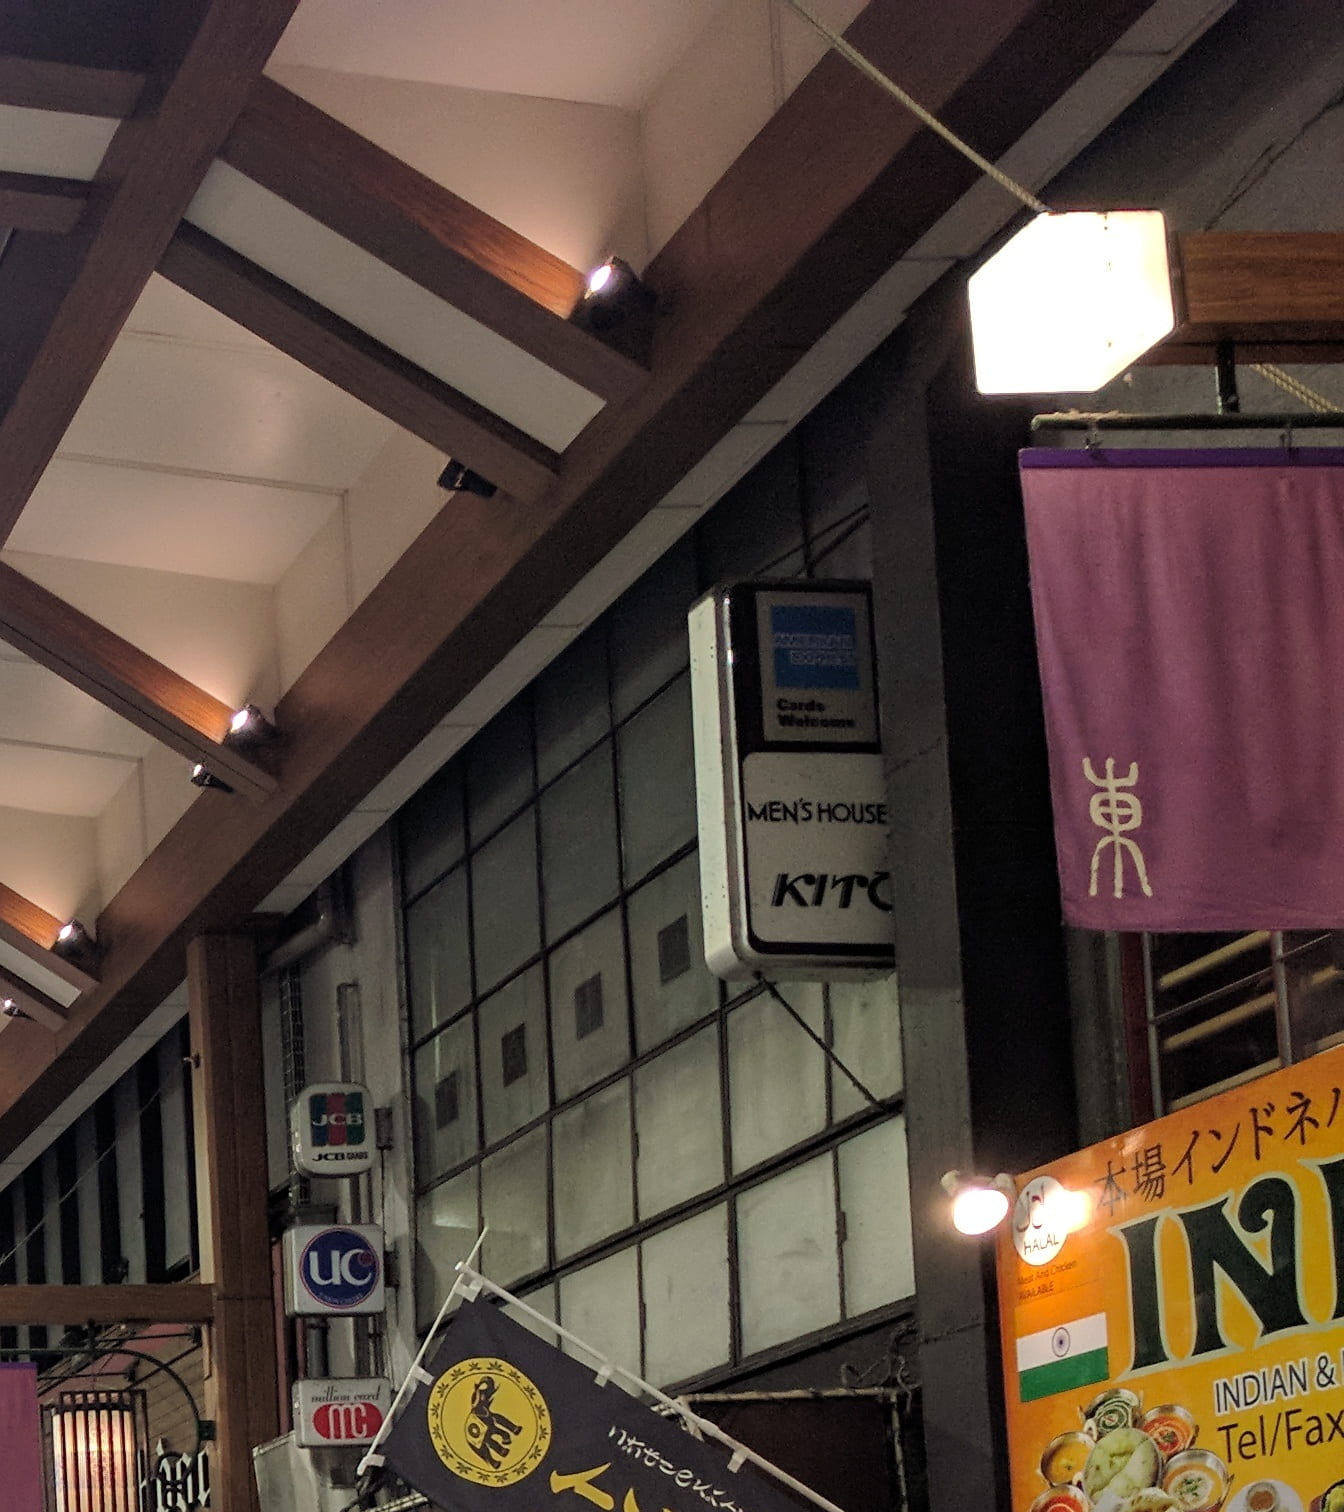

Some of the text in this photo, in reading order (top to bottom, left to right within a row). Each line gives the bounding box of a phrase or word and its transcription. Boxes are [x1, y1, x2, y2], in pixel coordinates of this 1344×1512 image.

[776, 698, 826, 713] Cards
[776, 713, 856, 729] Welcome
[747, 797, 888, 826] MEN'S HOUSE
[312, 1113, 363, 1126] JCB
[312, 1152, 345, 1162] JCB
[1024, 1234, 1060, 1256] HALAL
[1214, 1354, 1337, 1415] INDIAN &
